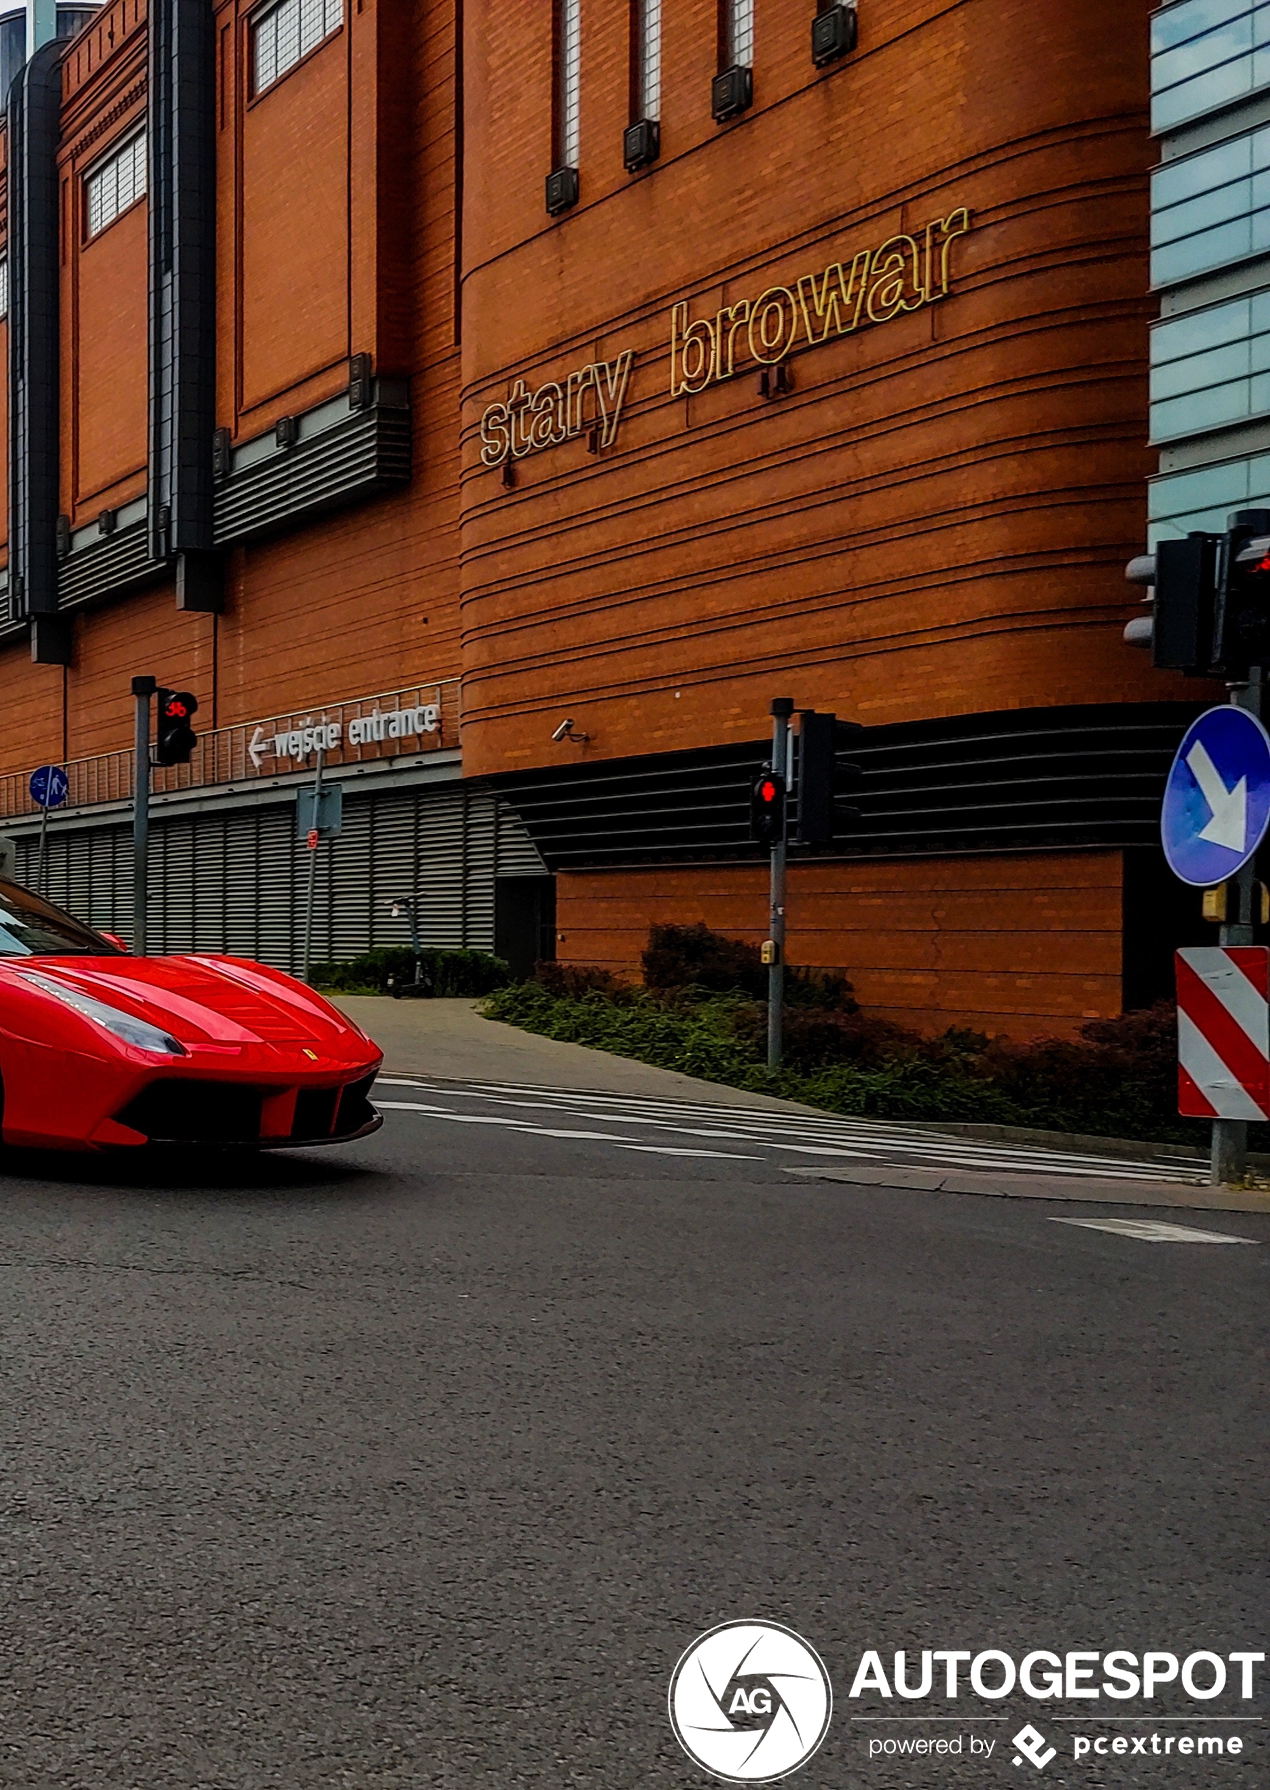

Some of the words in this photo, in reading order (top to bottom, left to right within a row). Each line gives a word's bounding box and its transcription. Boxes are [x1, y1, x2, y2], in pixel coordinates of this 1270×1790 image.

[480, 349, 634, 466] stary
[670, 206, 969, 397] browar
[274, 716, 341, 762] wejście
[349, 704, 440, 745] entrance
